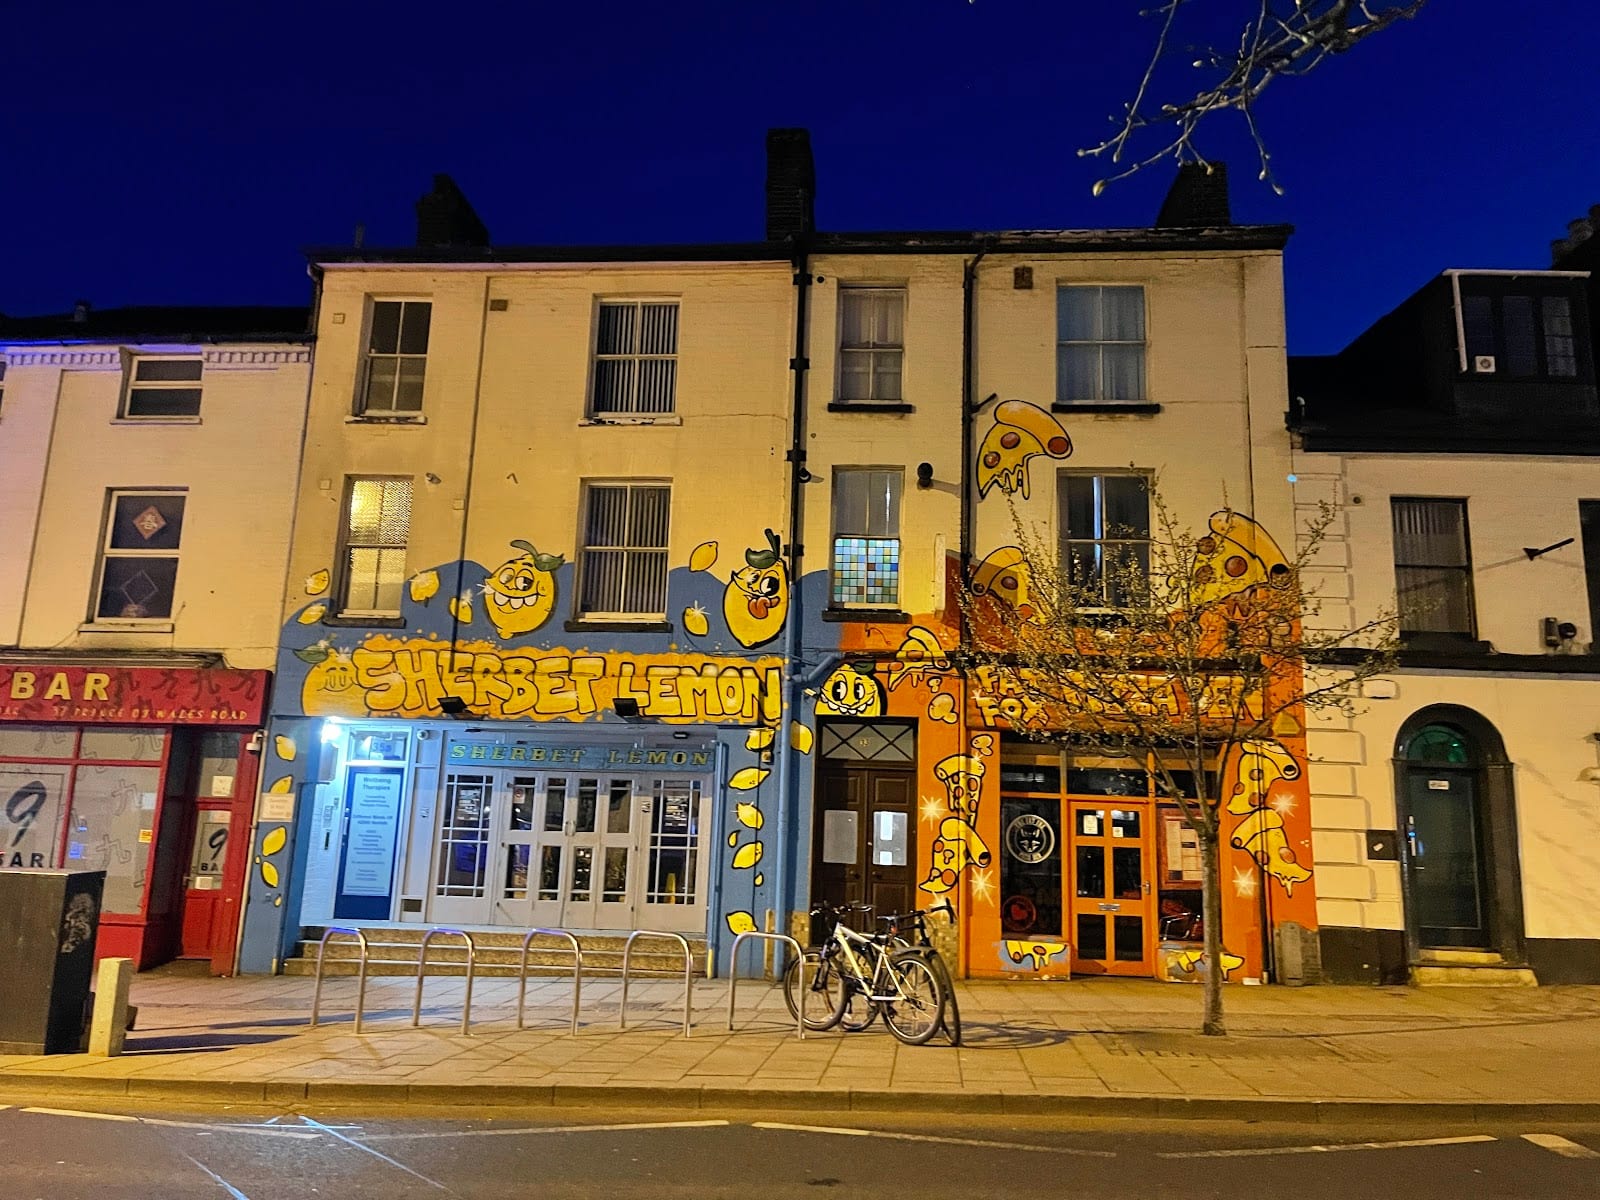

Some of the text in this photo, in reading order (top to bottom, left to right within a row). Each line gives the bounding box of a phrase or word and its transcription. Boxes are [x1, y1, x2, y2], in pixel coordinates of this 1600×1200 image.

[10, 671, 111, 701] BAR
[352, 647, 782, 720] SHERBET LEMON
[975, 665, 1048, 696] FAT
[74, 707, 124, 718] PRINCE
[131, 708, 149, 718] OF
[156, 709, 204, 719] WALES
[211, 710, 248, 720] ROAD
[975, 695, 1049, 727] FOX
[451, 744, 712, 767] SHERBET LEMON
[6, 781, 47, 847] 9
[208, 828, 229, 861] 9
[200, 862, 224, 871] BA
